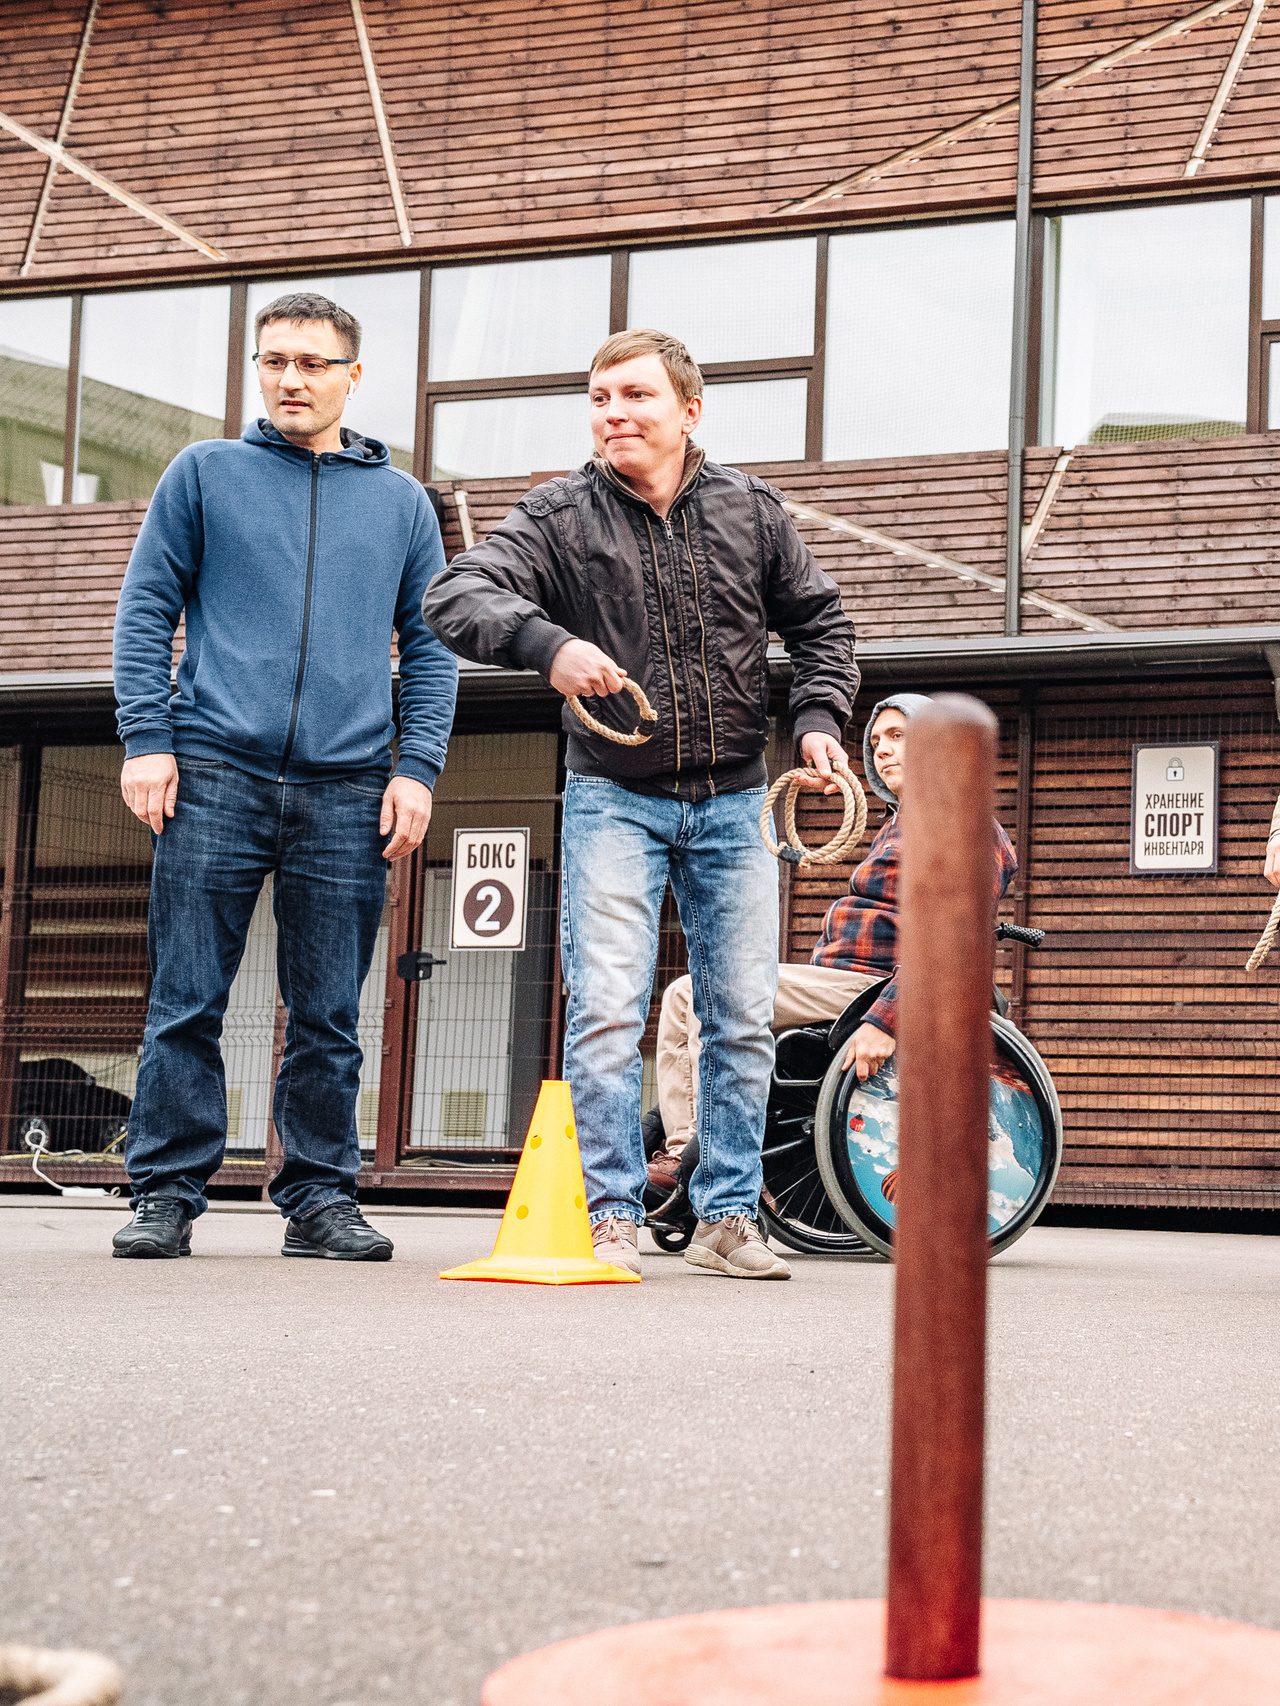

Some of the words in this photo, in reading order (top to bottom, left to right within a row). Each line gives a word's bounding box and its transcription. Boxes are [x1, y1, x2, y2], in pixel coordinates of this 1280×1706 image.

[1145, 793, 1204, 809] ХРАНЕНИЕ
[1145, 813, 1204, 837] СПОРТ
[467, 843, 516, 869] БОКС
[1144, 841, 1204, 856] ИНВЕНТАРЯ
[474, 885, 502, 931] 2
